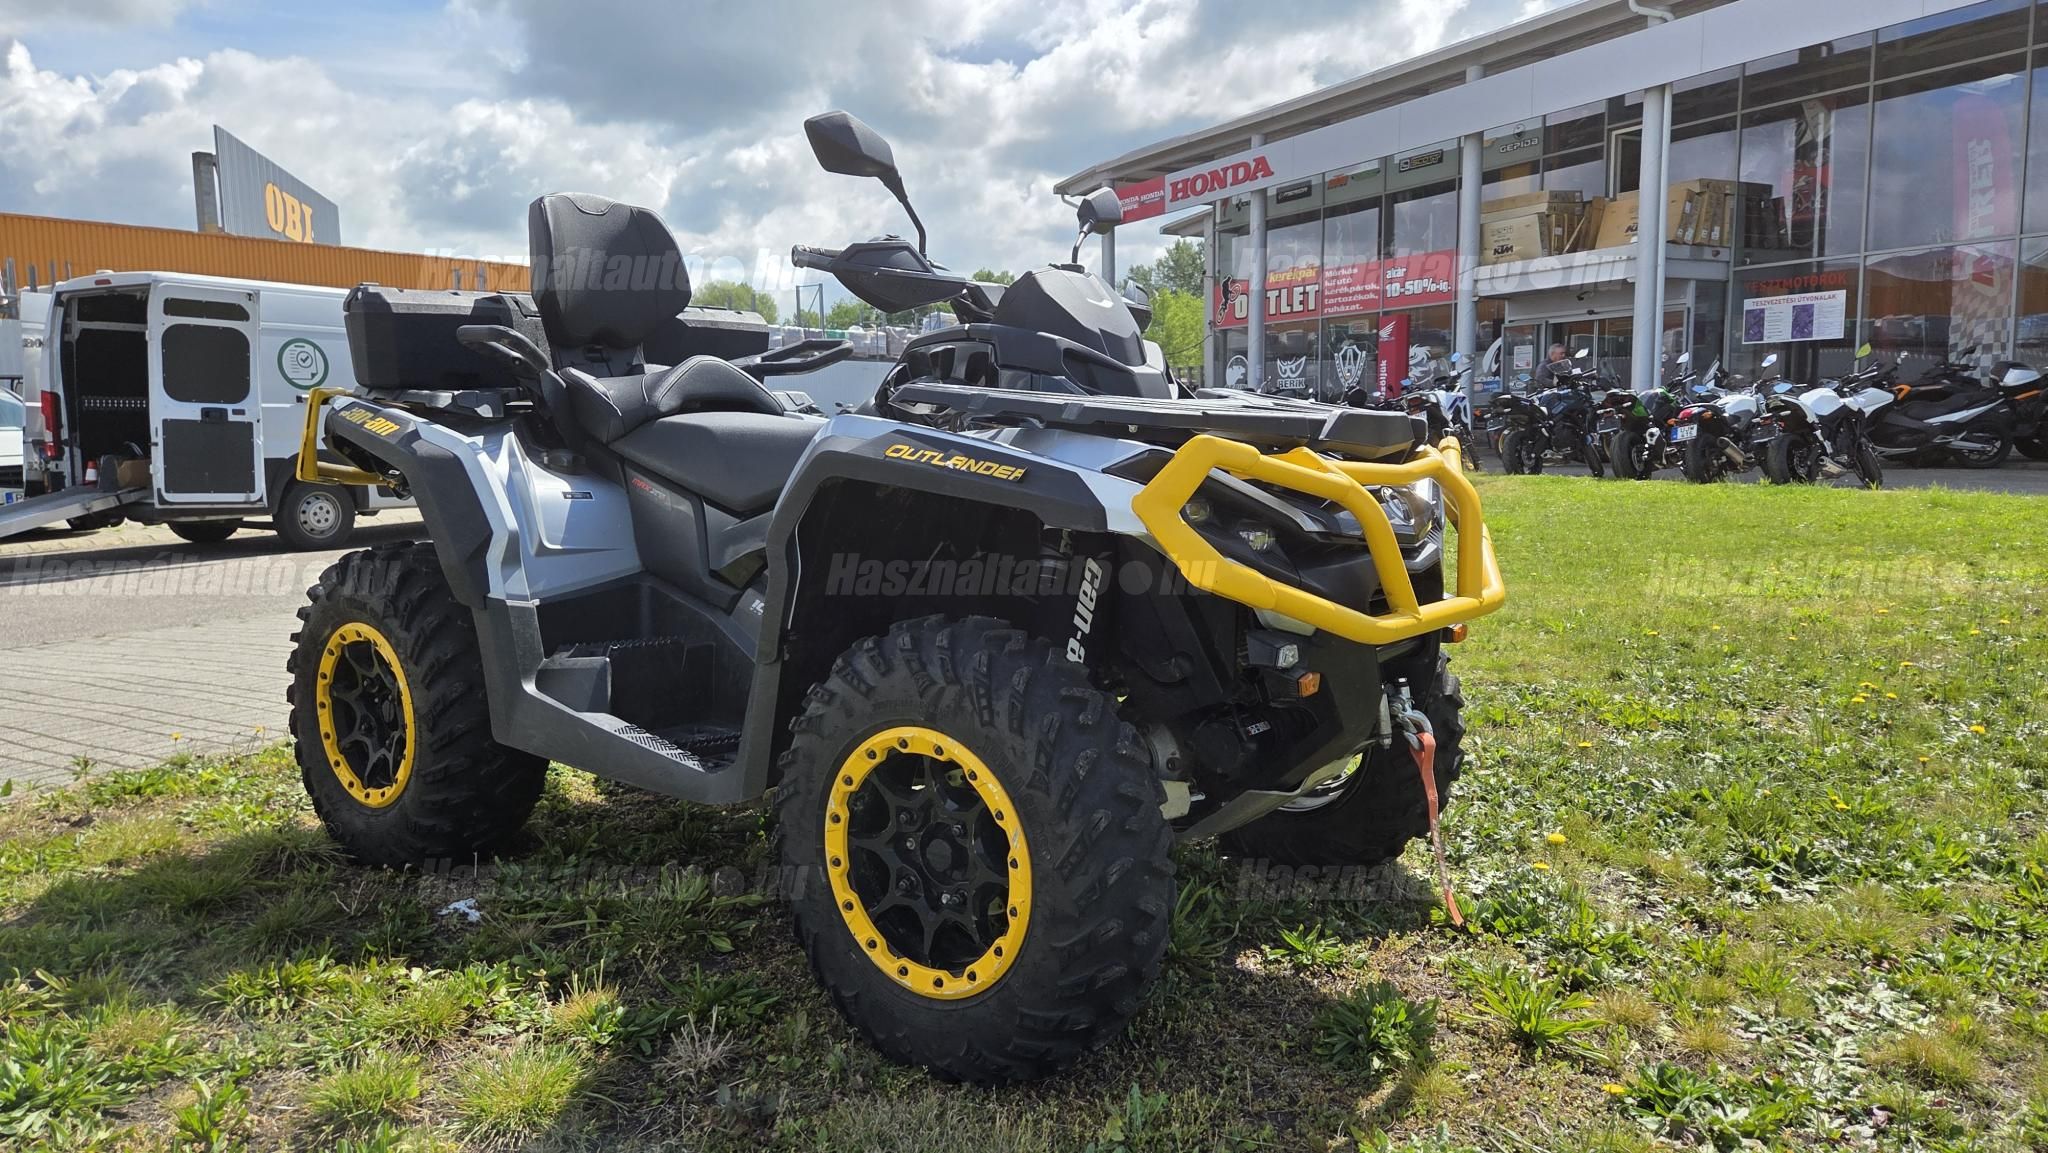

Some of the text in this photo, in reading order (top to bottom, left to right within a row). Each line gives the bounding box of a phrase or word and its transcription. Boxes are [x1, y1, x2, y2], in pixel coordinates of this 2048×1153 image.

[1169, 155, 1275, 203] HONDA
[265, 182, 314, 243] OBI
[1492, 243, 1514, 256] KTM
[1269, 267, 1318, 283] kerékpár
[1386, 266, 1407, 279] akár
[1235, 283, 1319, 319] OTLET
[884, 444, 1027, 481] OUTLANDER
[1066, 557, 1103, 663] can-a
